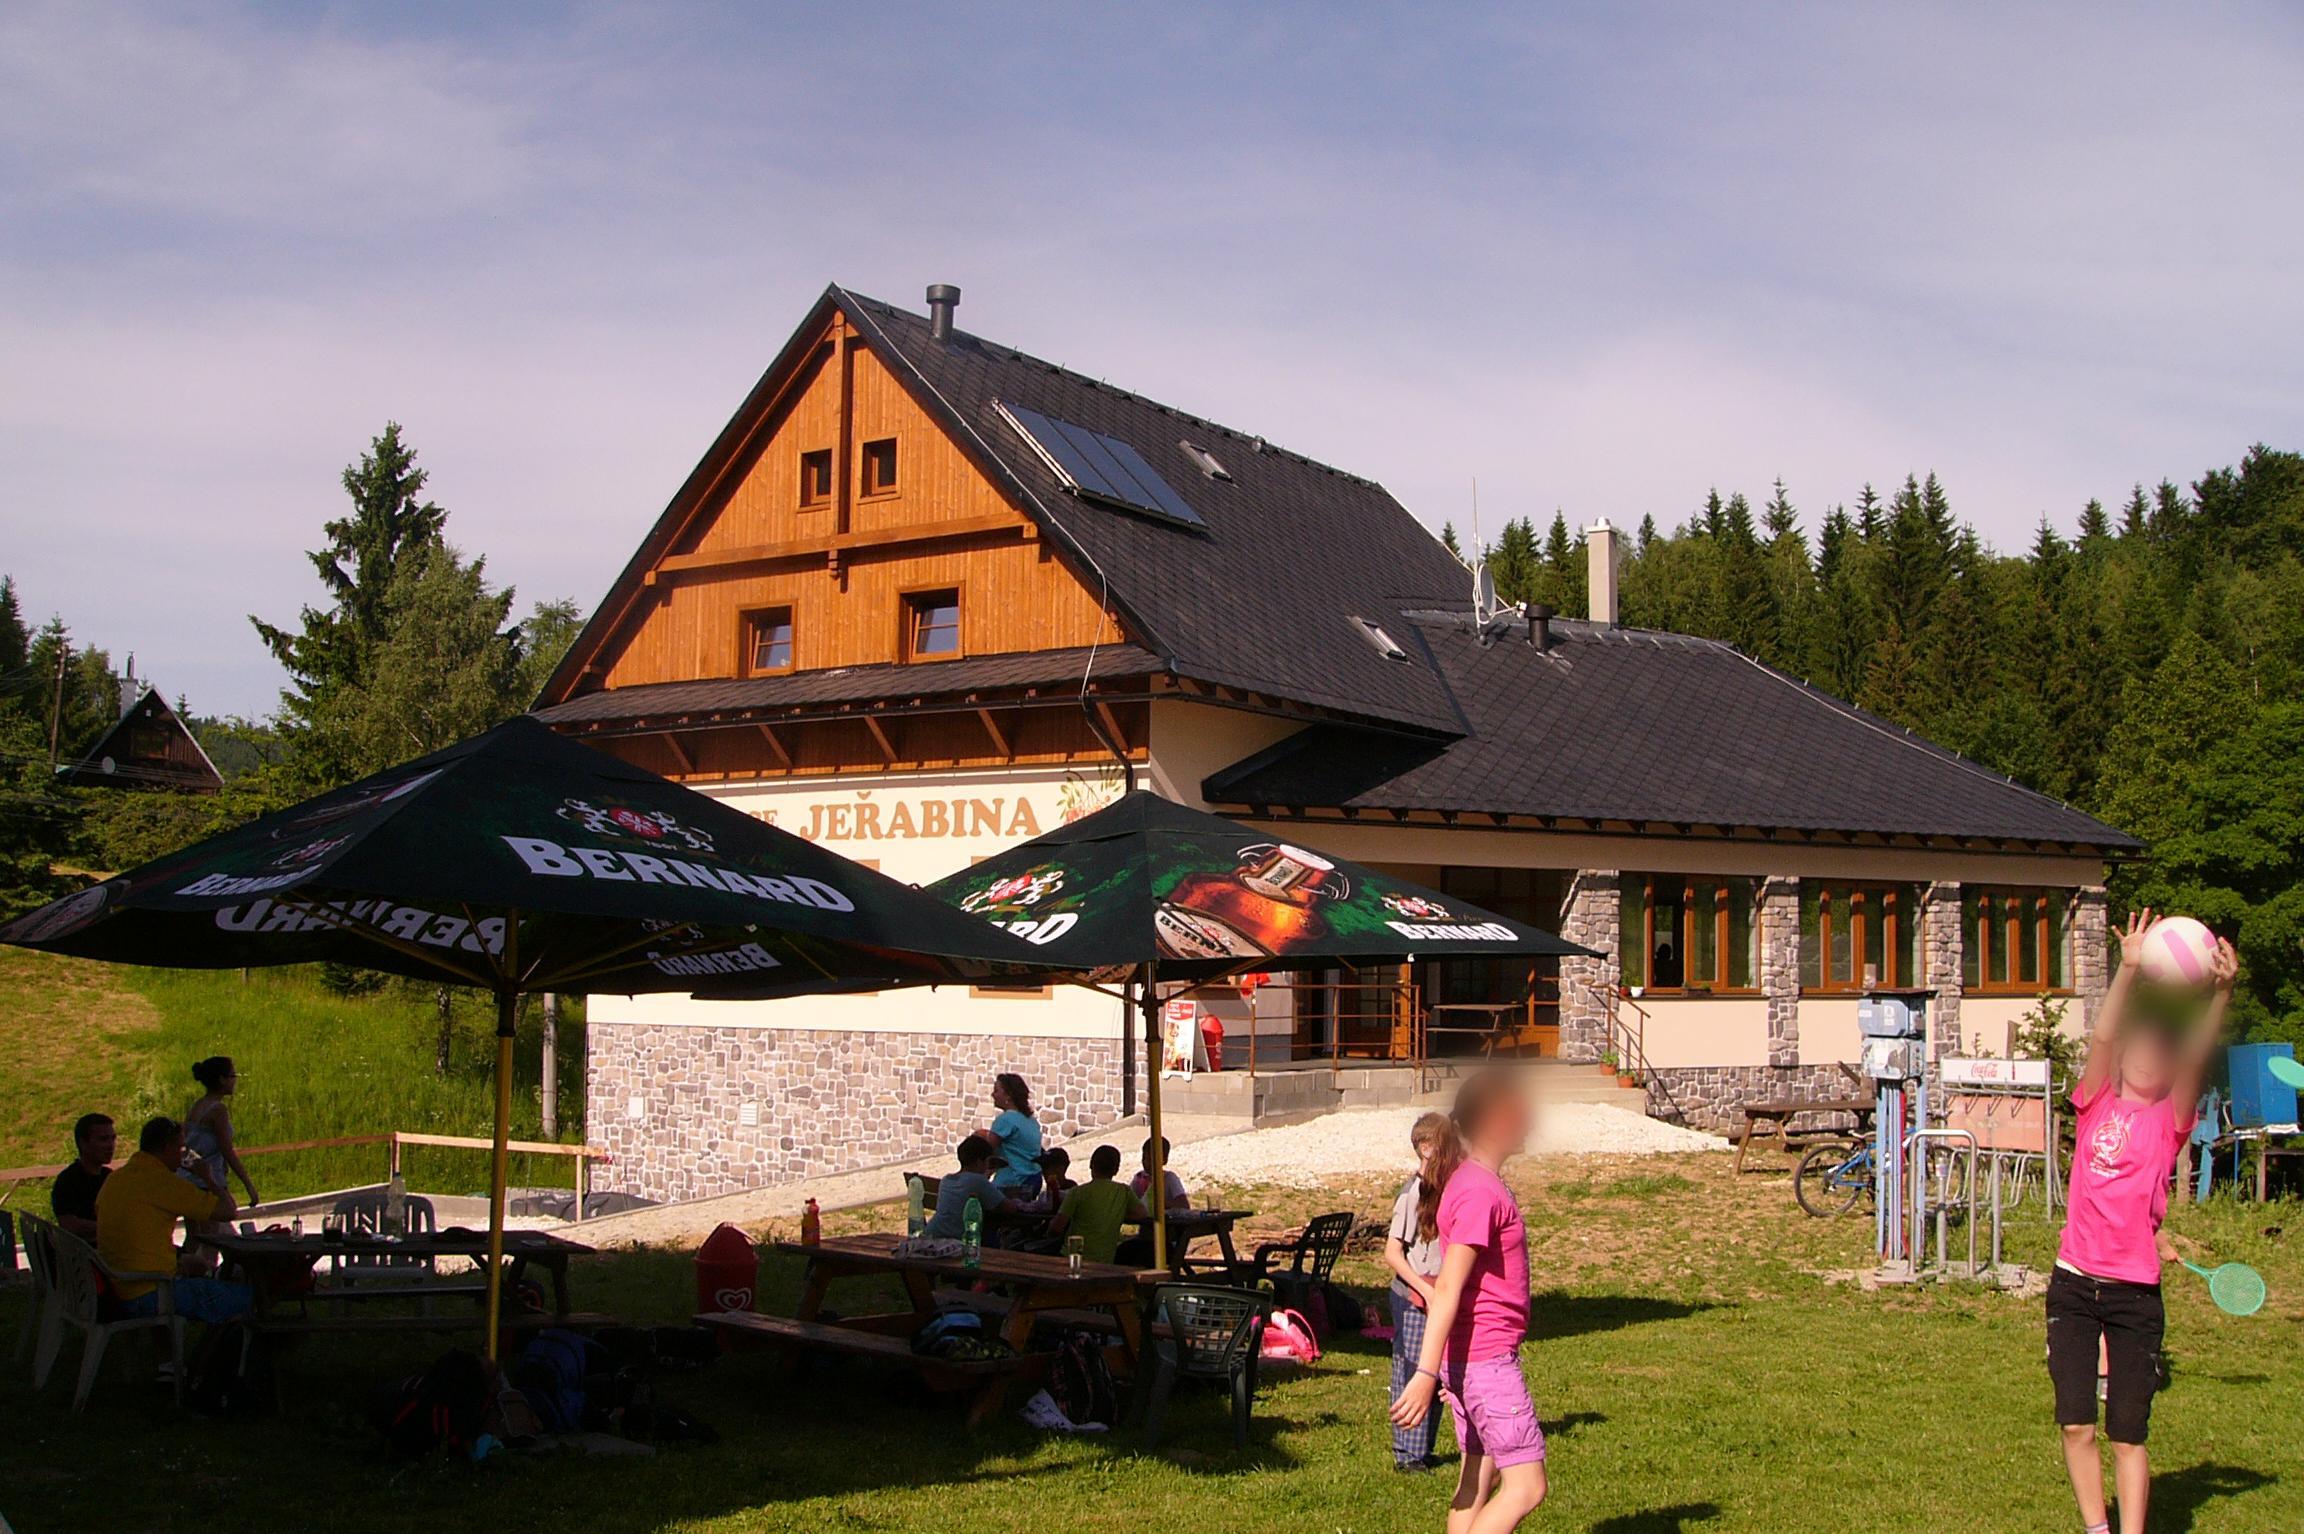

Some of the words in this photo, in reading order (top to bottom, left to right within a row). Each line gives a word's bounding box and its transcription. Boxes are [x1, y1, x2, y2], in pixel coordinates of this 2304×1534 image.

[800, 791, 1042, 841] JEŘABINA
[500, 835, 855, 912] BERNARD
[1384, 921, 1519, 941] BERNARD
